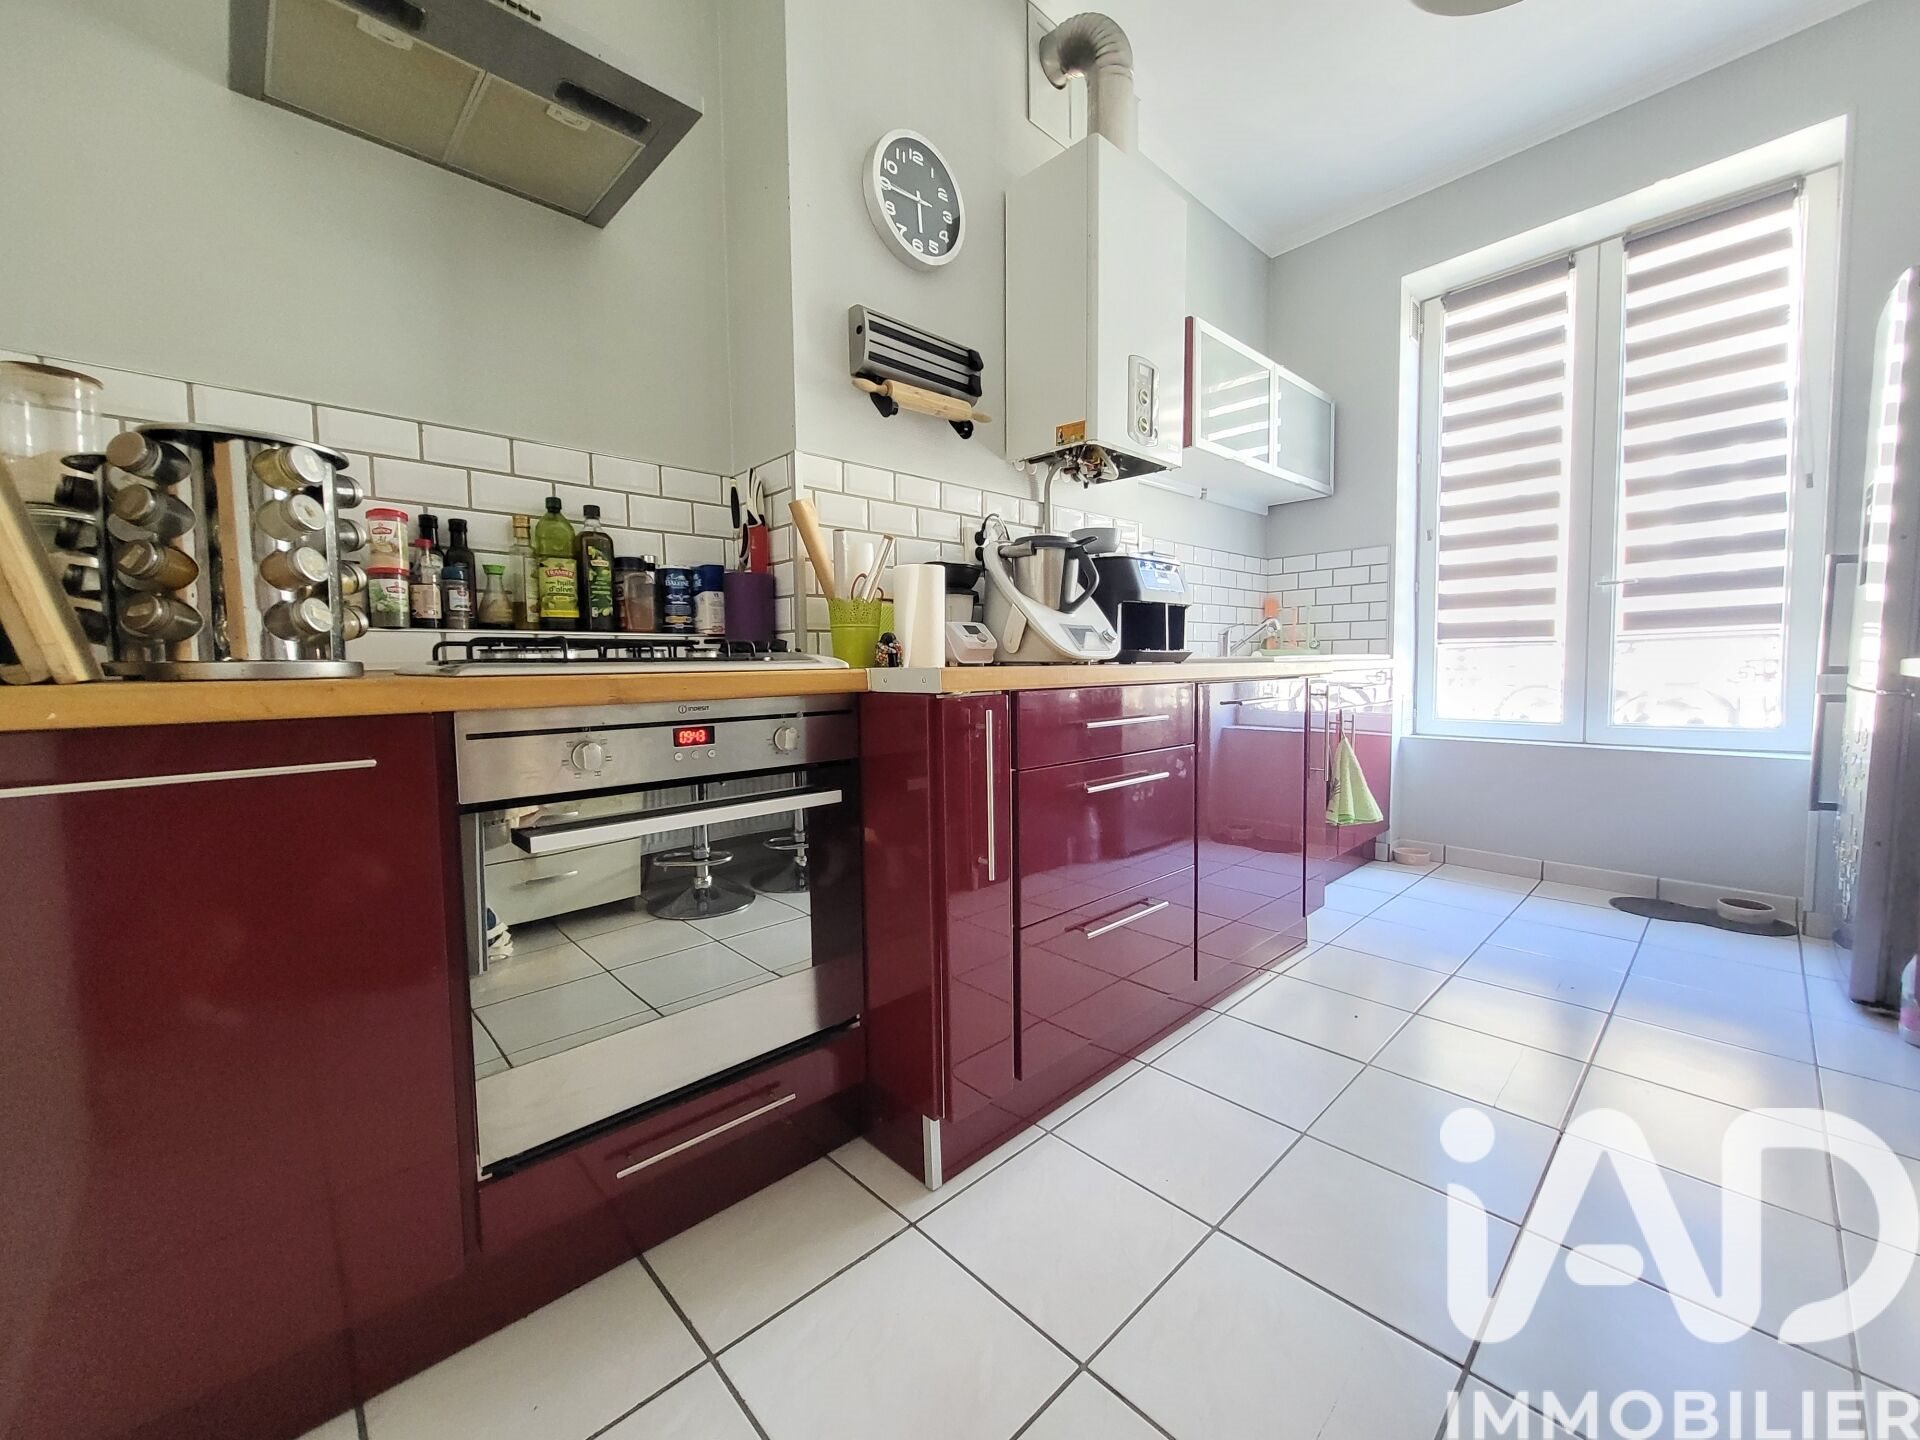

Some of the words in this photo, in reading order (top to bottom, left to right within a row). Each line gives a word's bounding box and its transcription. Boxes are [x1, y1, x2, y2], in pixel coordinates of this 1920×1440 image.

[895, 147, 906, 163] 11
[908, 148, 924, 166] 12
[883, 158, 898, 175] 10
[930, 167, 935, 179] 1
[880, 176, 892, 191] 9
[937, 188, 949, 203] 2
[885, 200, 897, 216] 8
[942, 210, 953, 225] 3
[895, 222, 908, 238] 7
[939, 230, 950, 244] 4
[912, 238, 924, 253] 6
[928, 239, 939, 255] 5
